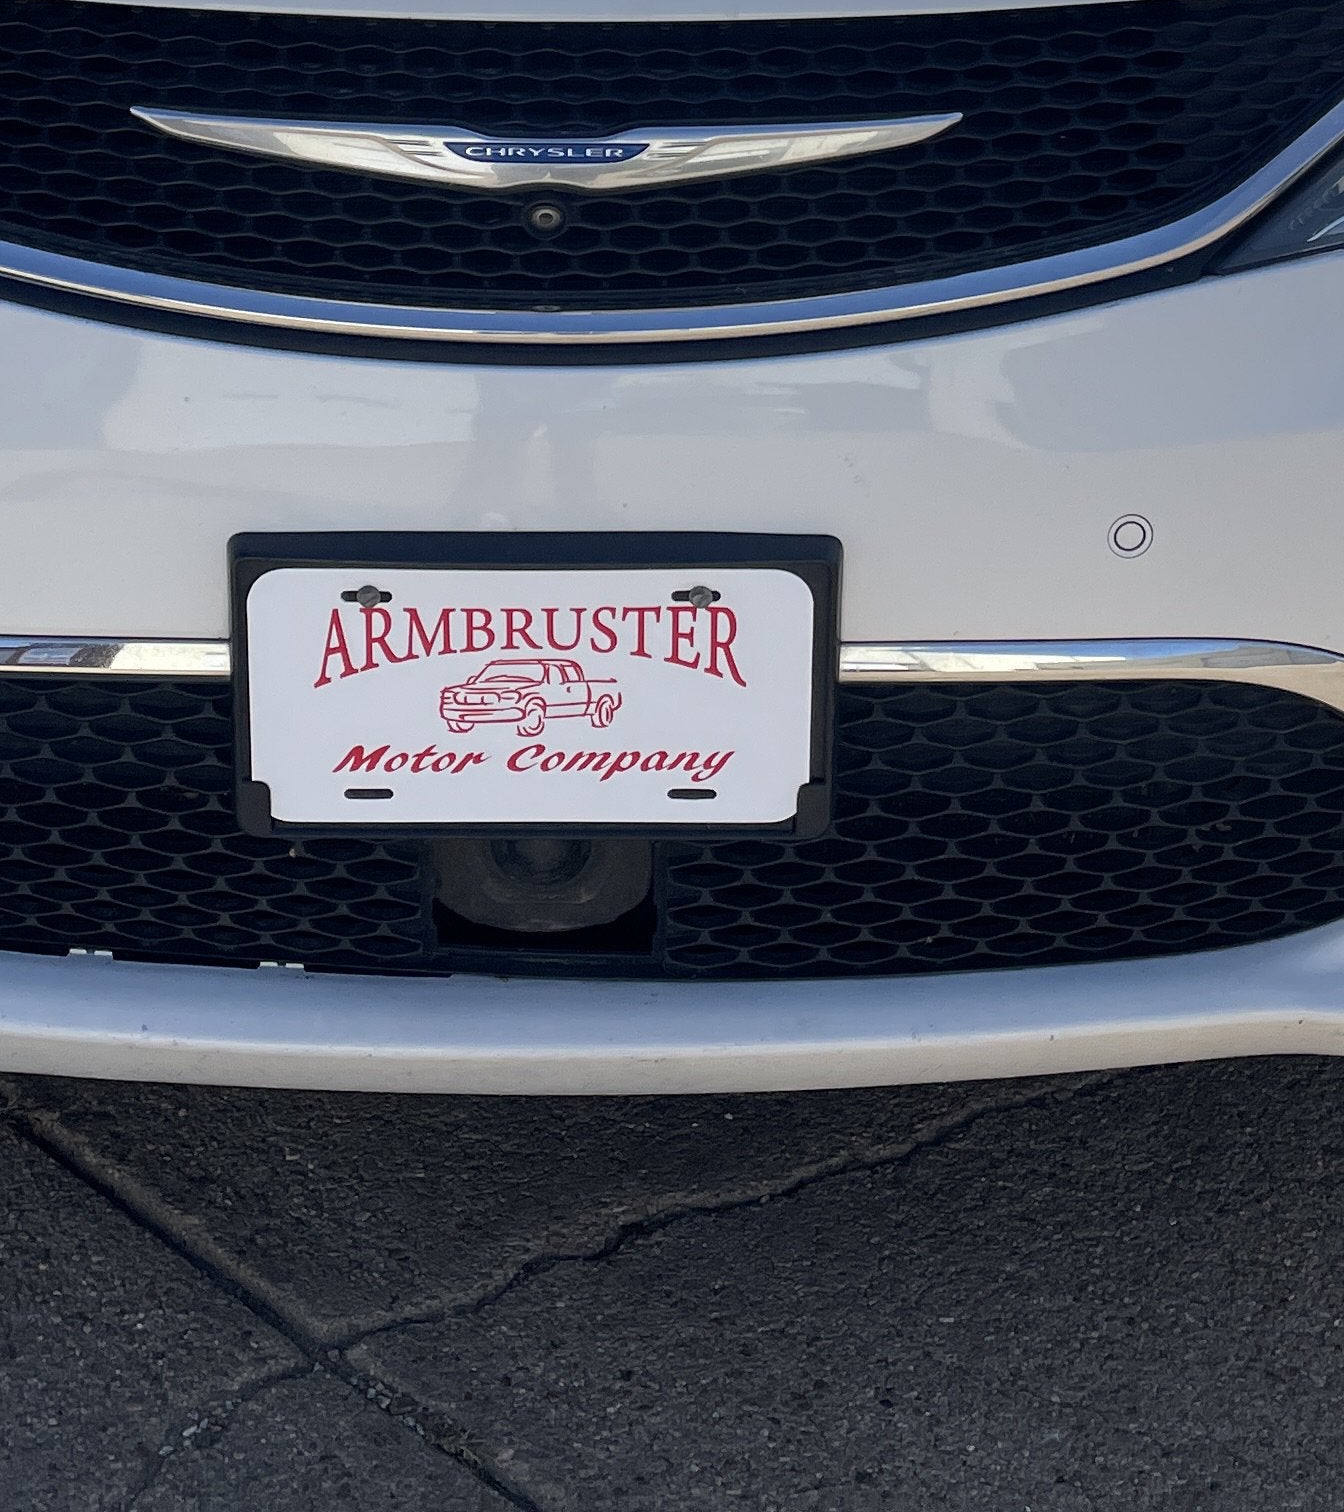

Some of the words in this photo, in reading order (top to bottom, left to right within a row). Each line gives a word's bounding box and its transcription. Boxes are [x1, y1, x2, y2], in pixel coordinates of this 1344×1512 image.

[464, 145, 624, 159] CHRYSLER
[313, 605, 747, 689] ARMBRUSTER
[332, 744, 492, 774] Motor
[506, 743, 736, 783] Company
